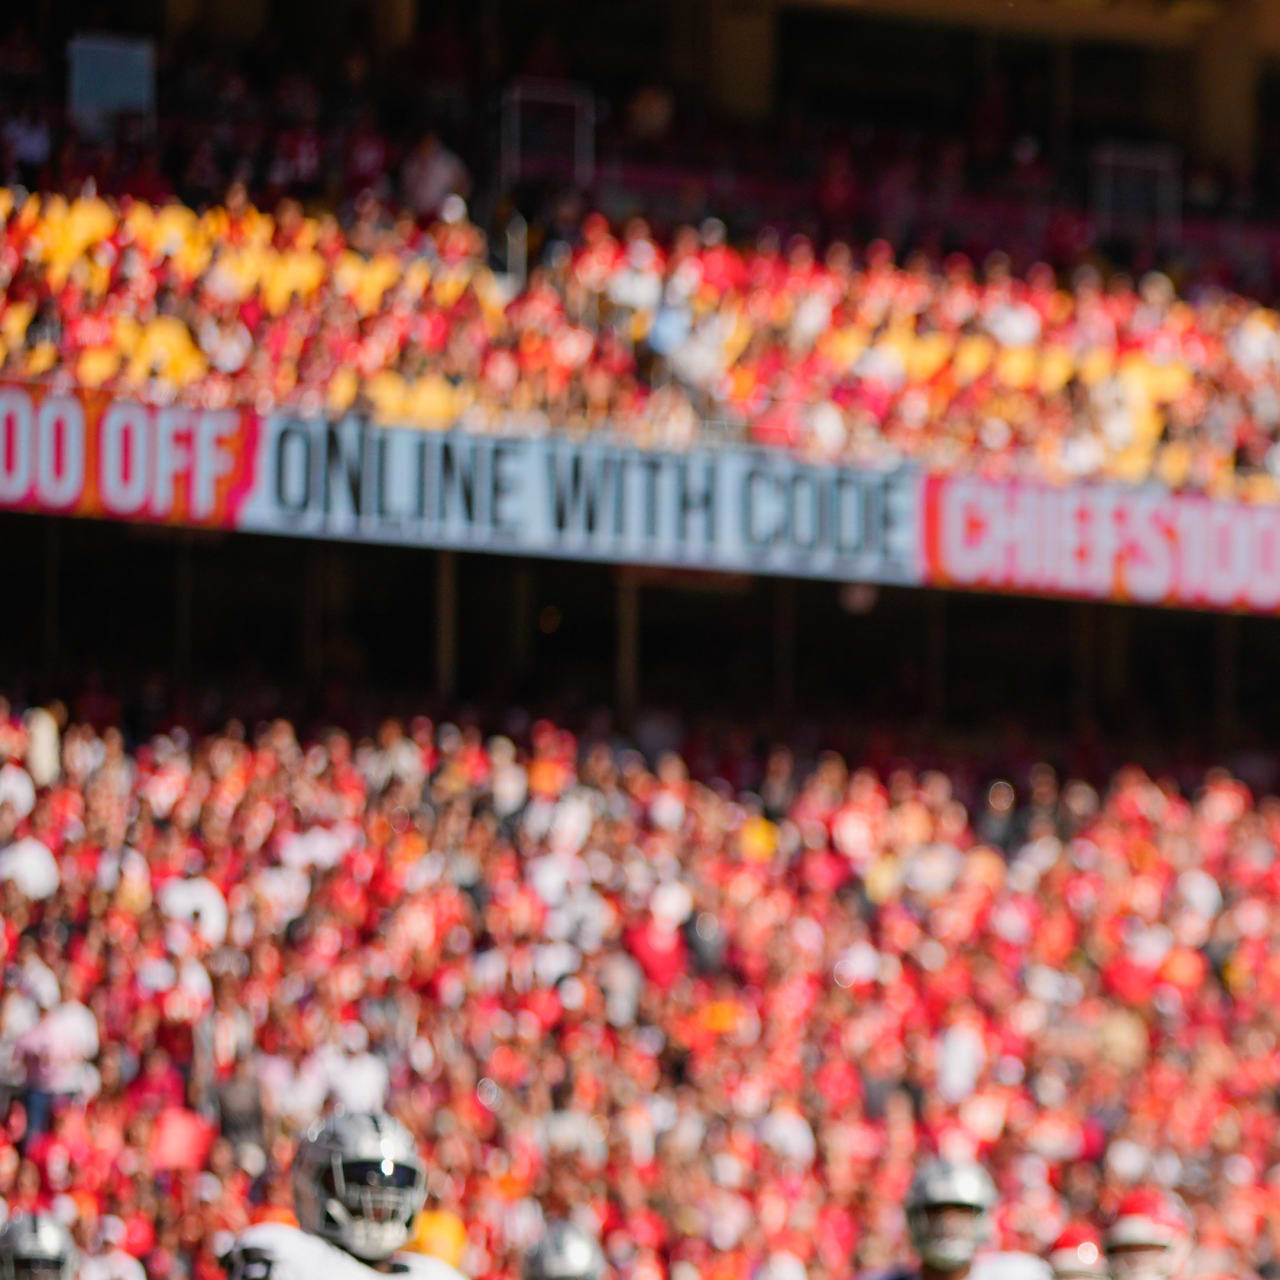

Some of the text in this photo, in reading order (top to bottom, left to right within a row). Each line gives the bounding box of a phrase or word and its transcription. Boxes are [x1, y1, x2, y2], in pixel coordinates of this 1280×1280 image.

[101, 400, 241, 520] OFF
[275, 418, 522, 532] ONLINE
[550, 444, 716, 549] WITH
[742, 466, 908, 559] CODE
